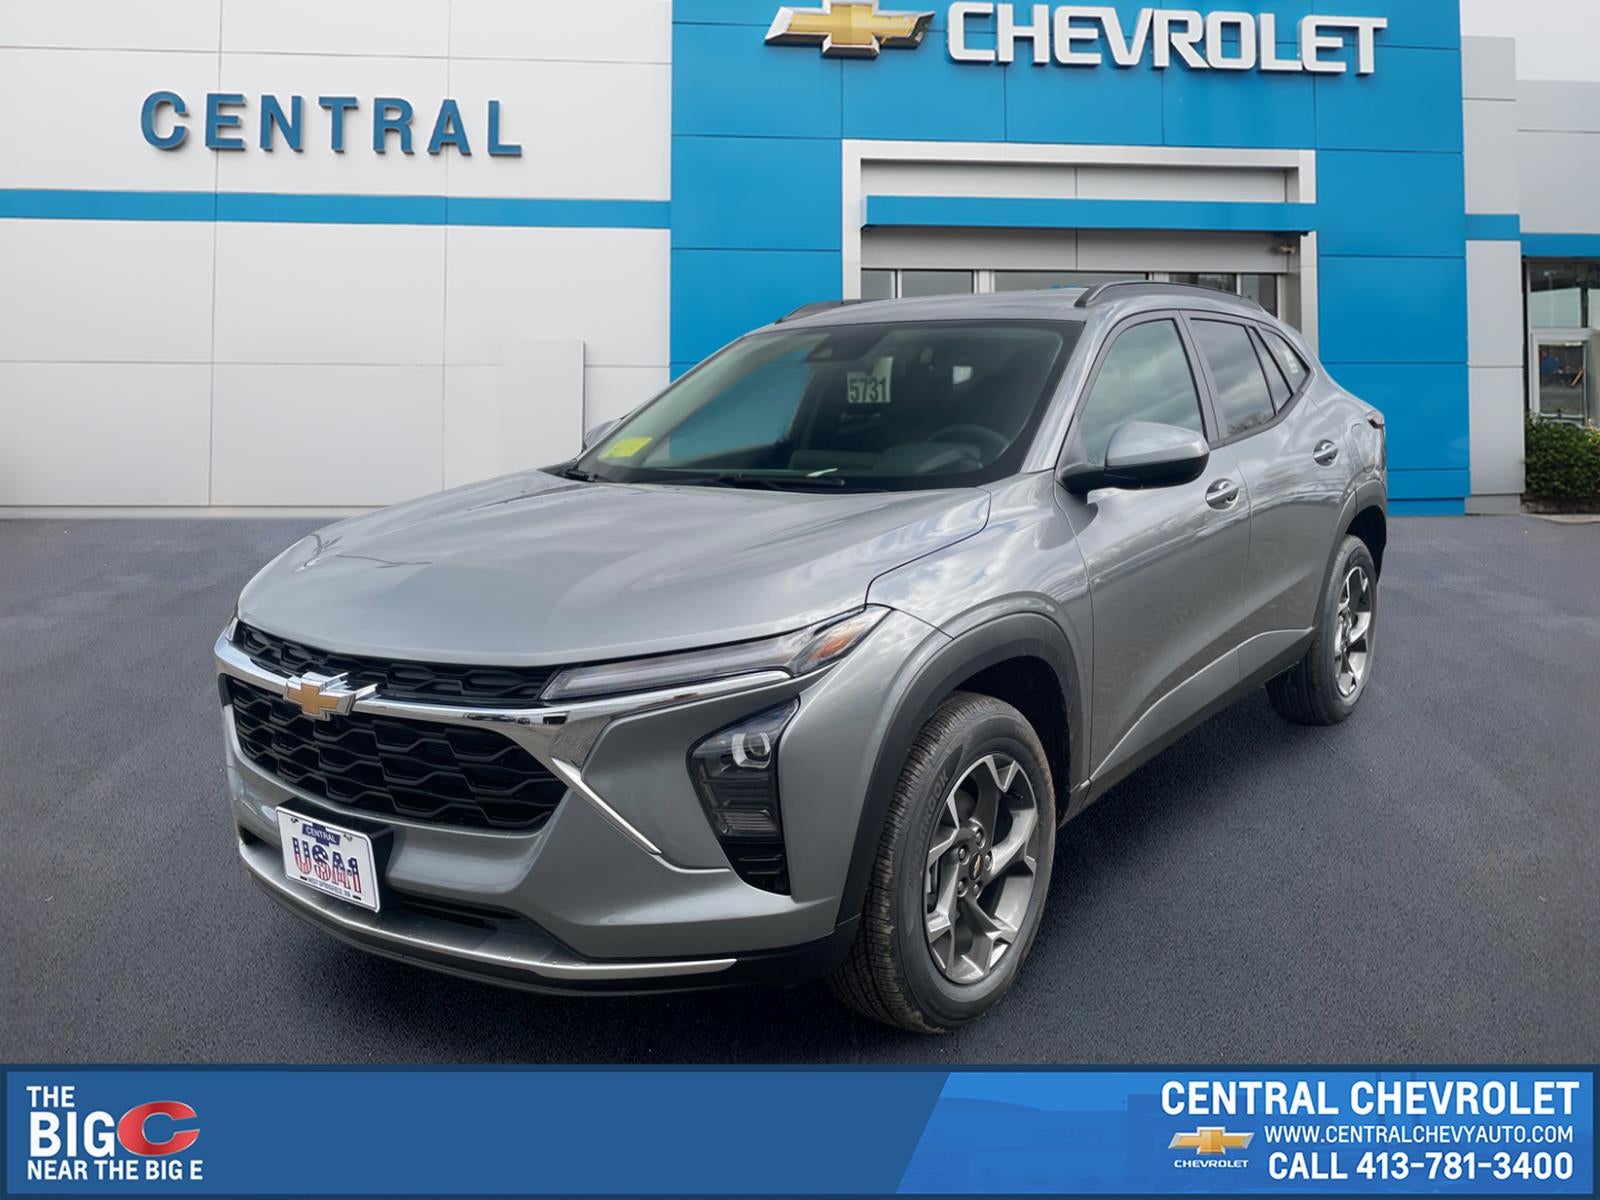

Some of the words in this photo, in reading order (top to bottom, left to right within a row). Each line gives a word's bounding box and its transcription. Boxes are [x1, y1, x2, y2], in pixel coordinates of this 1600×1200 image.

[947, 1, 1388, 76] CHEVROLET
[140, 90, 523, 158] CENTRAL
[849, 376, 887, 402] 5731
[305, 826, 337, 843] CENTRAL
